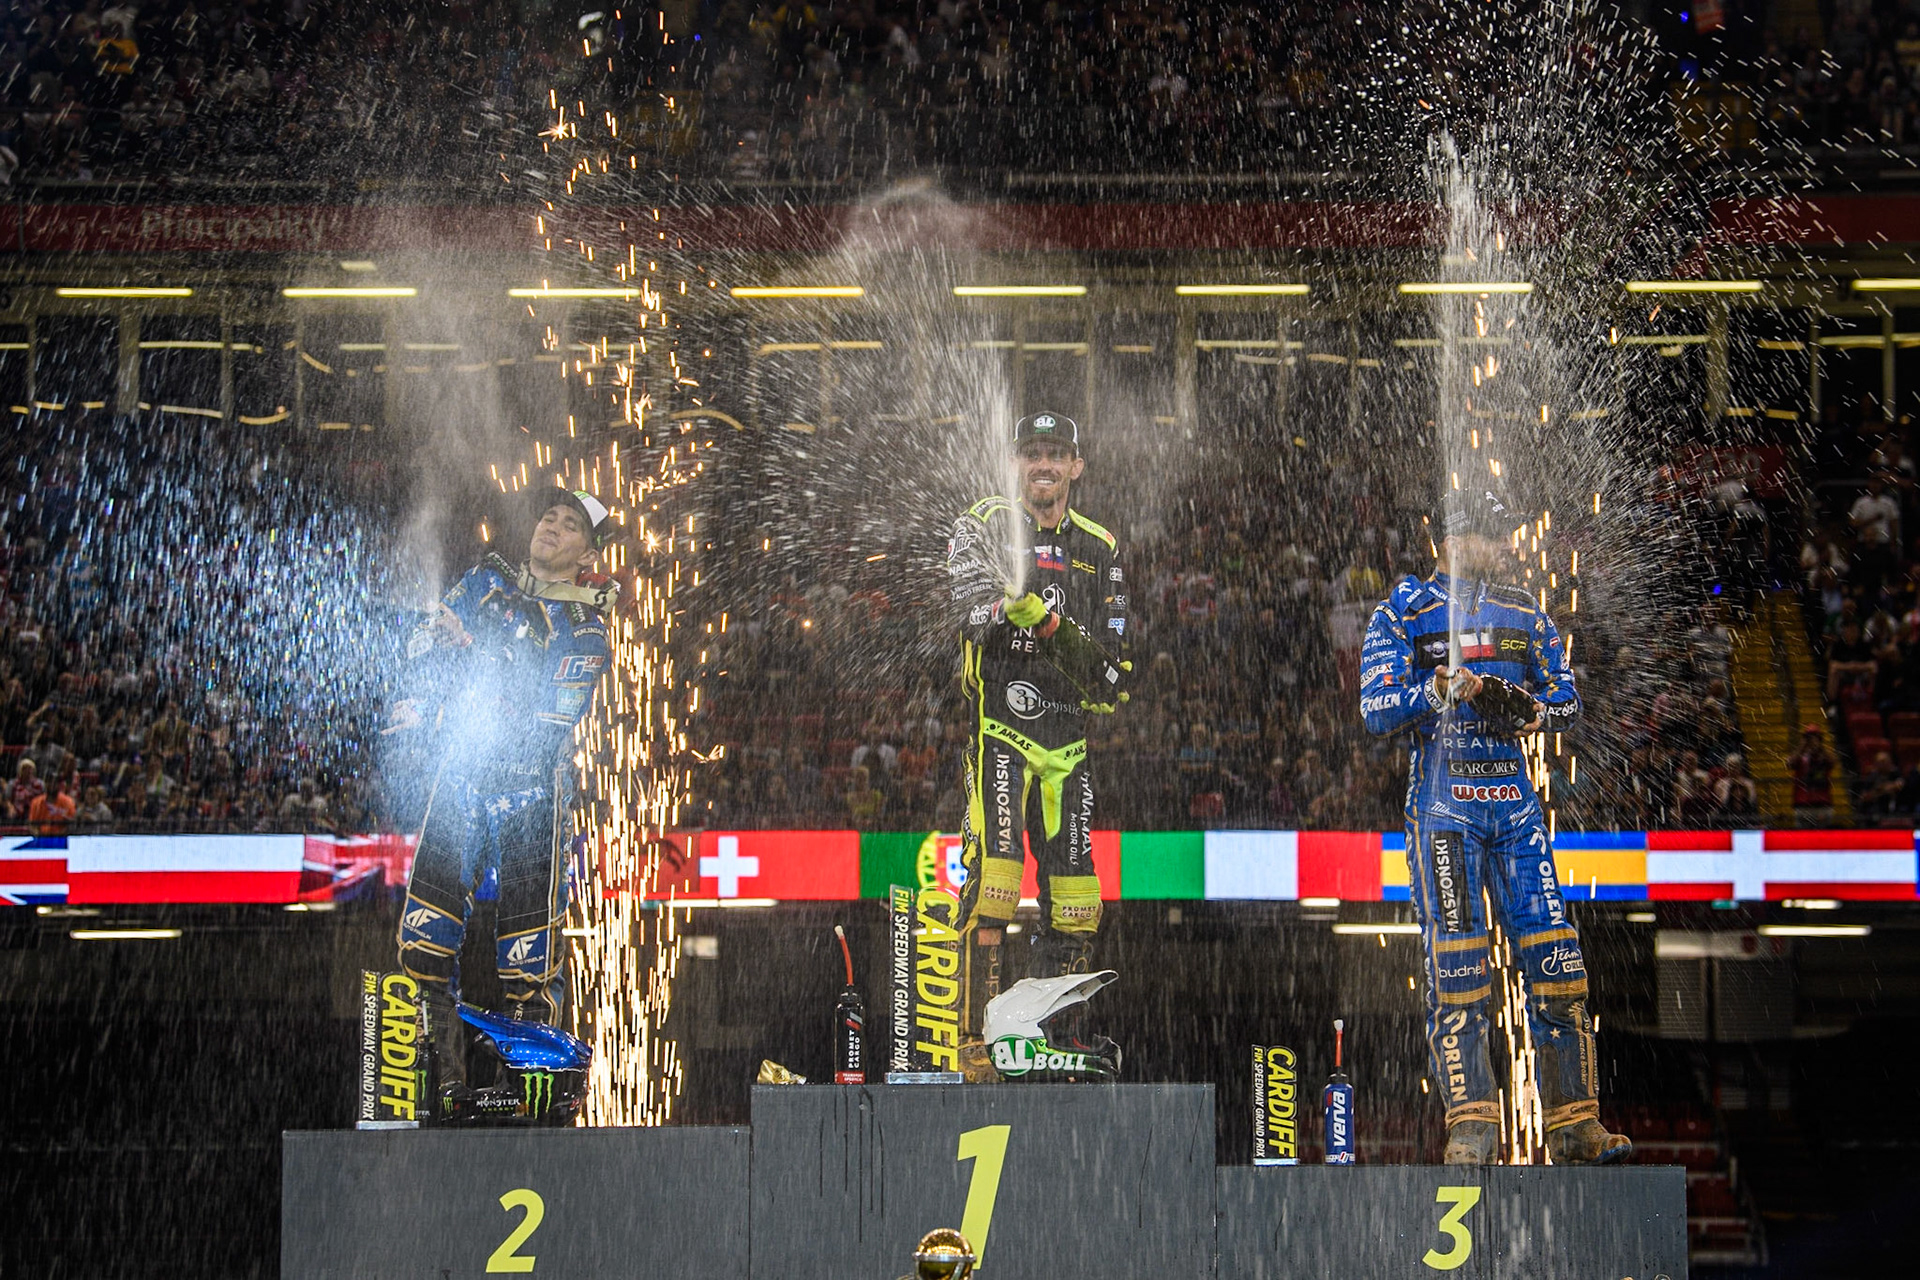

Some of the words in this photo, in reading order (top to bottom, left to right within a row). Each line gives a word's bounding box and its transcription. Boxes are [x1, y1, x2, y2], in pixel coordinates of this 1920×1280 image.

[143, 208, 326, 248] Principality
[1500, 640, 1526, 650] SGP
[999, 728, 1032, 751] ANLAS
[1451, 760, 1518, 774] GARCAREK
[993, 754, 1011, 854] MASZOŃSKI
[1069, 813, 1078, 847] MOTOR
[894, 888, 909, 914] FIM
[984, 892, 1013, 902] CARGO
[985, 886, 1018, 897] PROMET
[1435, 838, 1459, 933] MASZOŃSKI
[1539, 860, 1564, 925] ORLEN
[894, 914, 909, 988] SPEEDWAY
[363, 972, 377, 994] FIM
[915, 890, 959, 1073] CARDIFF
[363, 994, 376, 1053] SPEEDWAY
[894, 989, 909, 1037] GRAND
[380, 974, 419, 1120] CARDIFF
[894, 1038, 909, 1072] PRIX
[1033, 1053, 1088, 1071] BOLL
[1253, 1047, 1264, 1063] FIM
[363, 1053, 375, 1092] GRAND
[1254, 1063, 1265, 1107] SPEEDWAY
[1442, 1034, 1468, 1102] ORLEN
[361, 1093, 375, 1120] PRIX
[476, 1098, 520, 1108] MONSTER
[1267, 1046, 1296, 1158] CARDIFF
[1254, 1107, 1265, 1139] GRAND
[1255, 1139, 1265, 1157] PRIX
[956, 1125, 1010, 1270] 1
[485, 1189, 545, 1273] 2
[1422, 1186, 1482, 1270] 3
